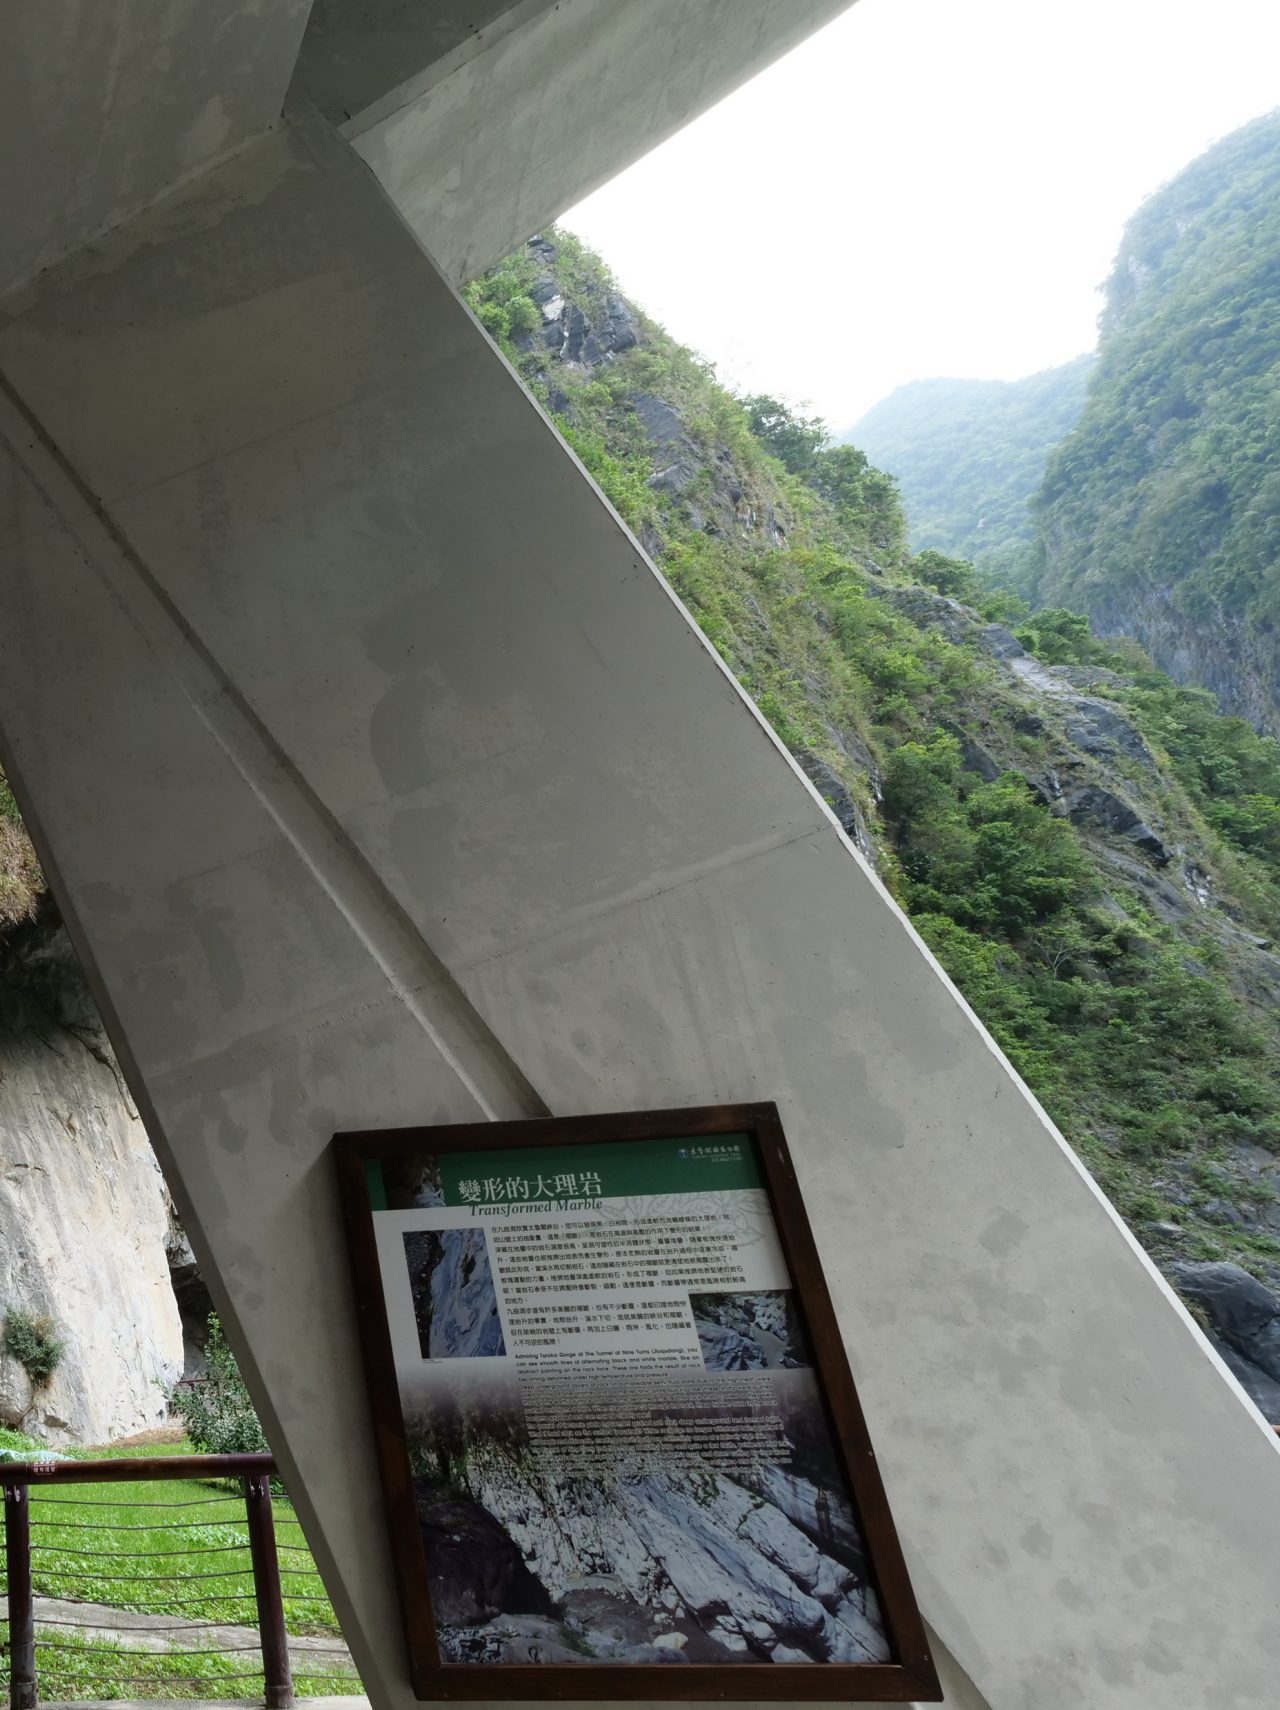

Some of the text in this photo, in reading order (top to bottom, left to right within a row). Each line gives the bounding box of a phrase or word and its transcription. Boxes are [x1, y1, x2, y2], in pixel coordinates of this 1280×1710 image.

[458, 1171, 602, 1202] 變形的大理岩
[468, 1198, 603, 1218] Transformed Marble
